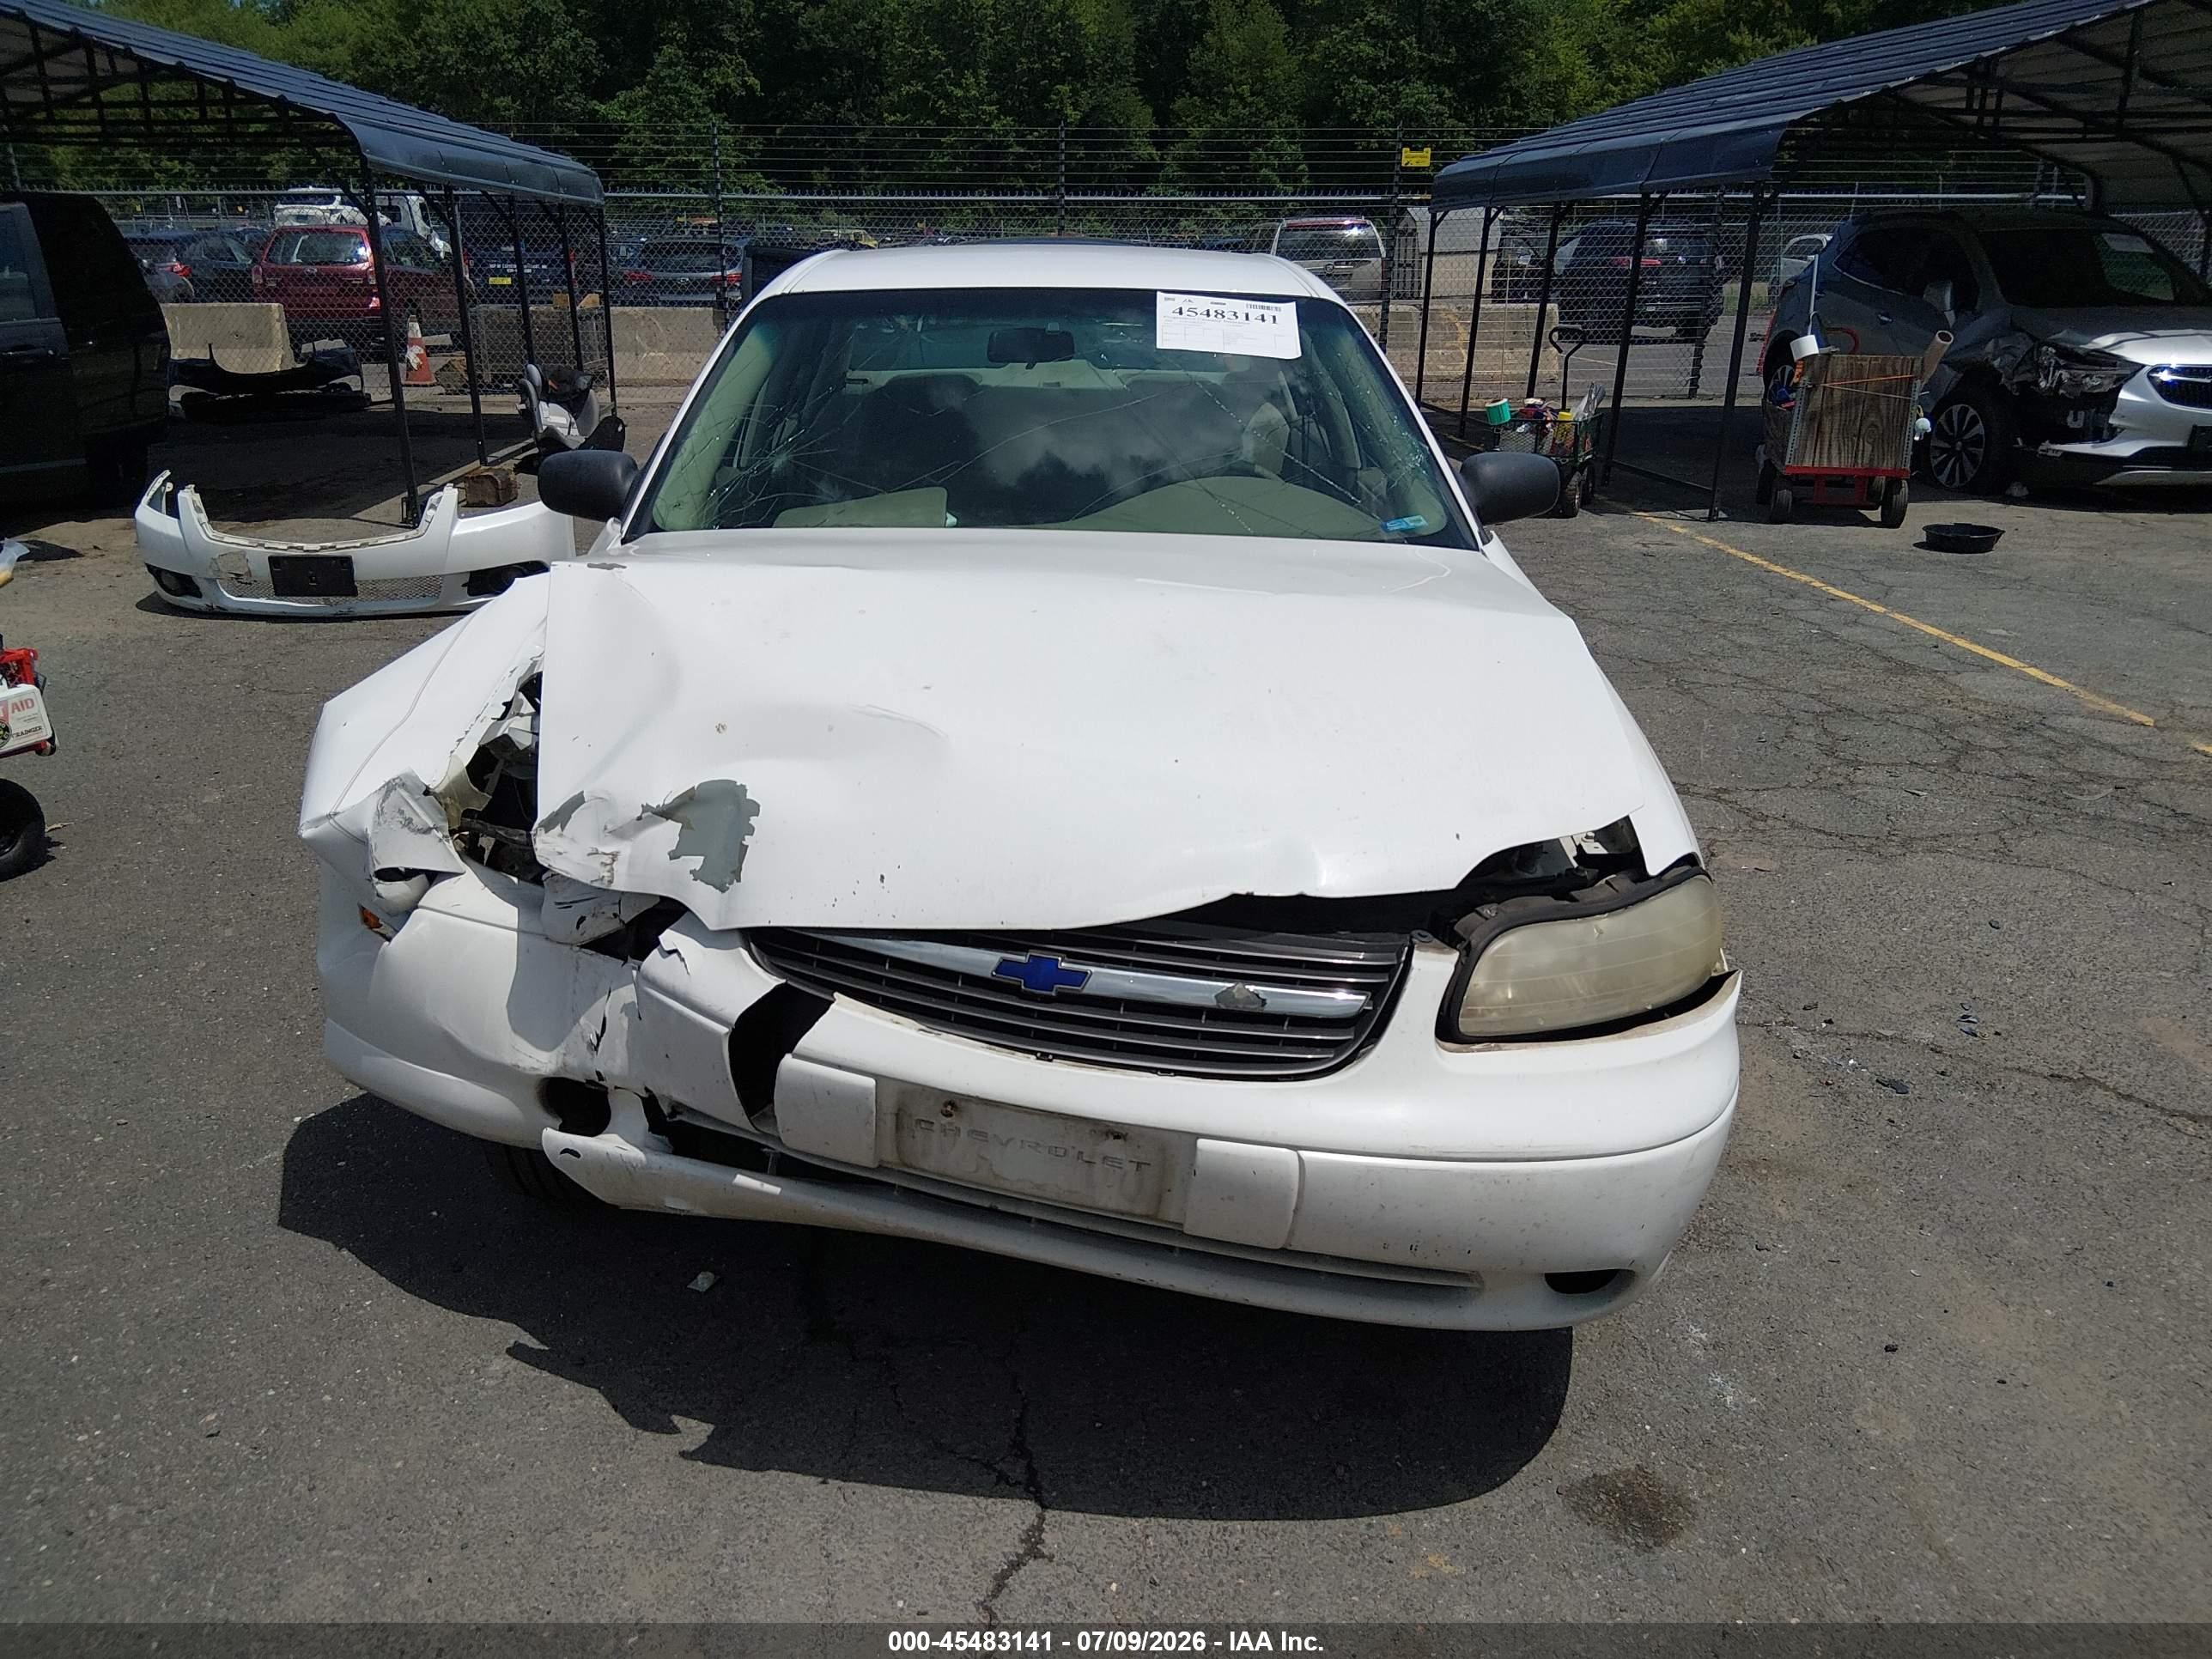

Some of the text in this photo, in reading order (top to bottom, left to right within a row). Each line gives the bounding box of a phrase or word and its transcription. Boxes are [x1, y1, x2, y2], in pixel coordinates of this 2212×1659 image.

[1171, 306, 1279, 325] 45483141
[11, 698, 34, 714] AID
[914, 1117, 1152, 1173] CHEVROLET
